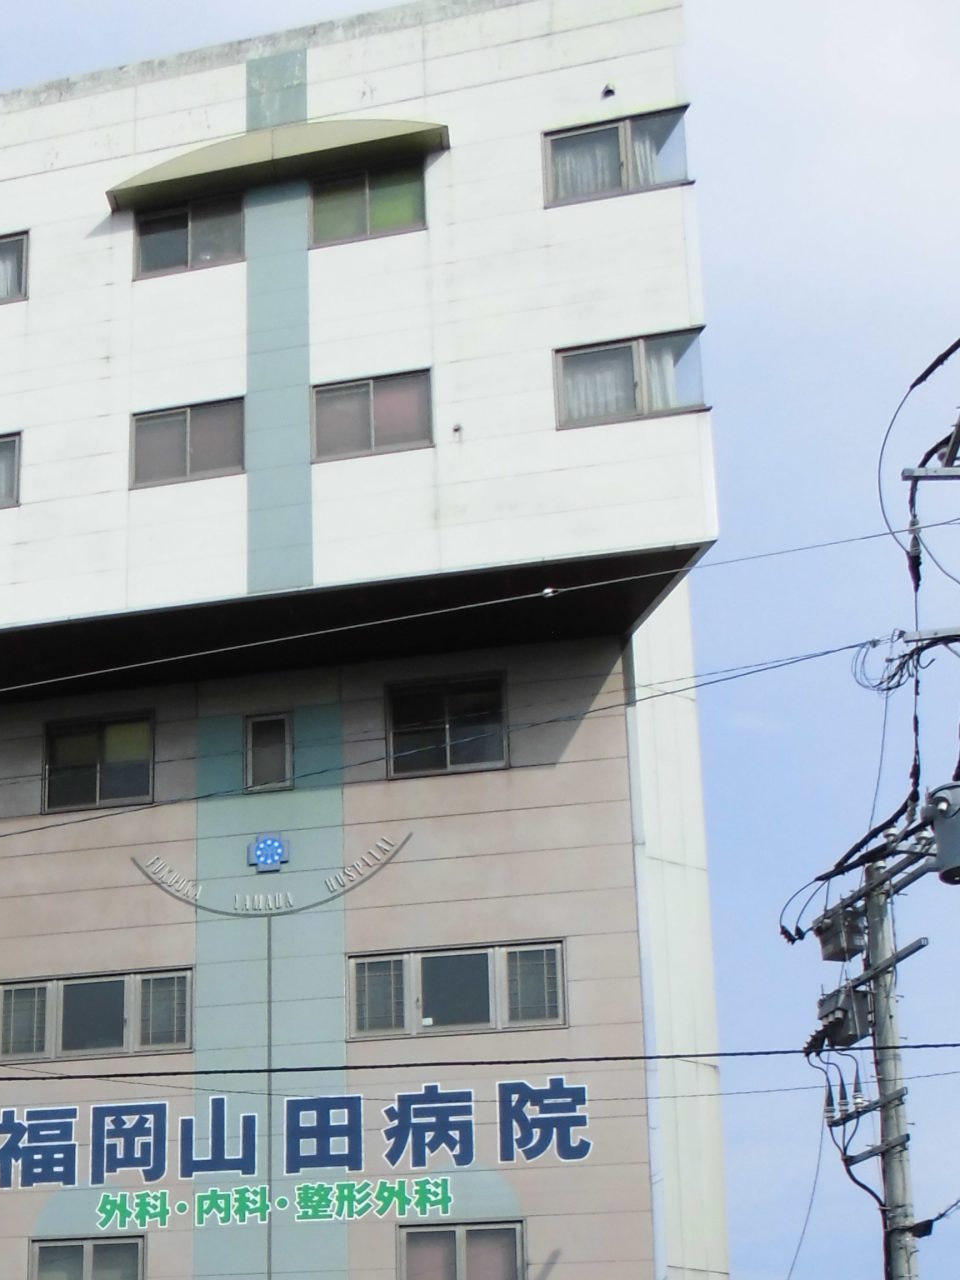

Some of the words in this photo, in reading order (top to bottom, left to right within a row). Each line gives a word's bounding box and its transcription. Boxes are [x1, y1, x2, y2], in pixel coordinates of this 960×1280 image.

[233, 891, 294, 911] YAMADA
[324, 835, 395, 893] HOSPITAL
[96, 1177, 453, 1230] 外科・内科・整形外科
